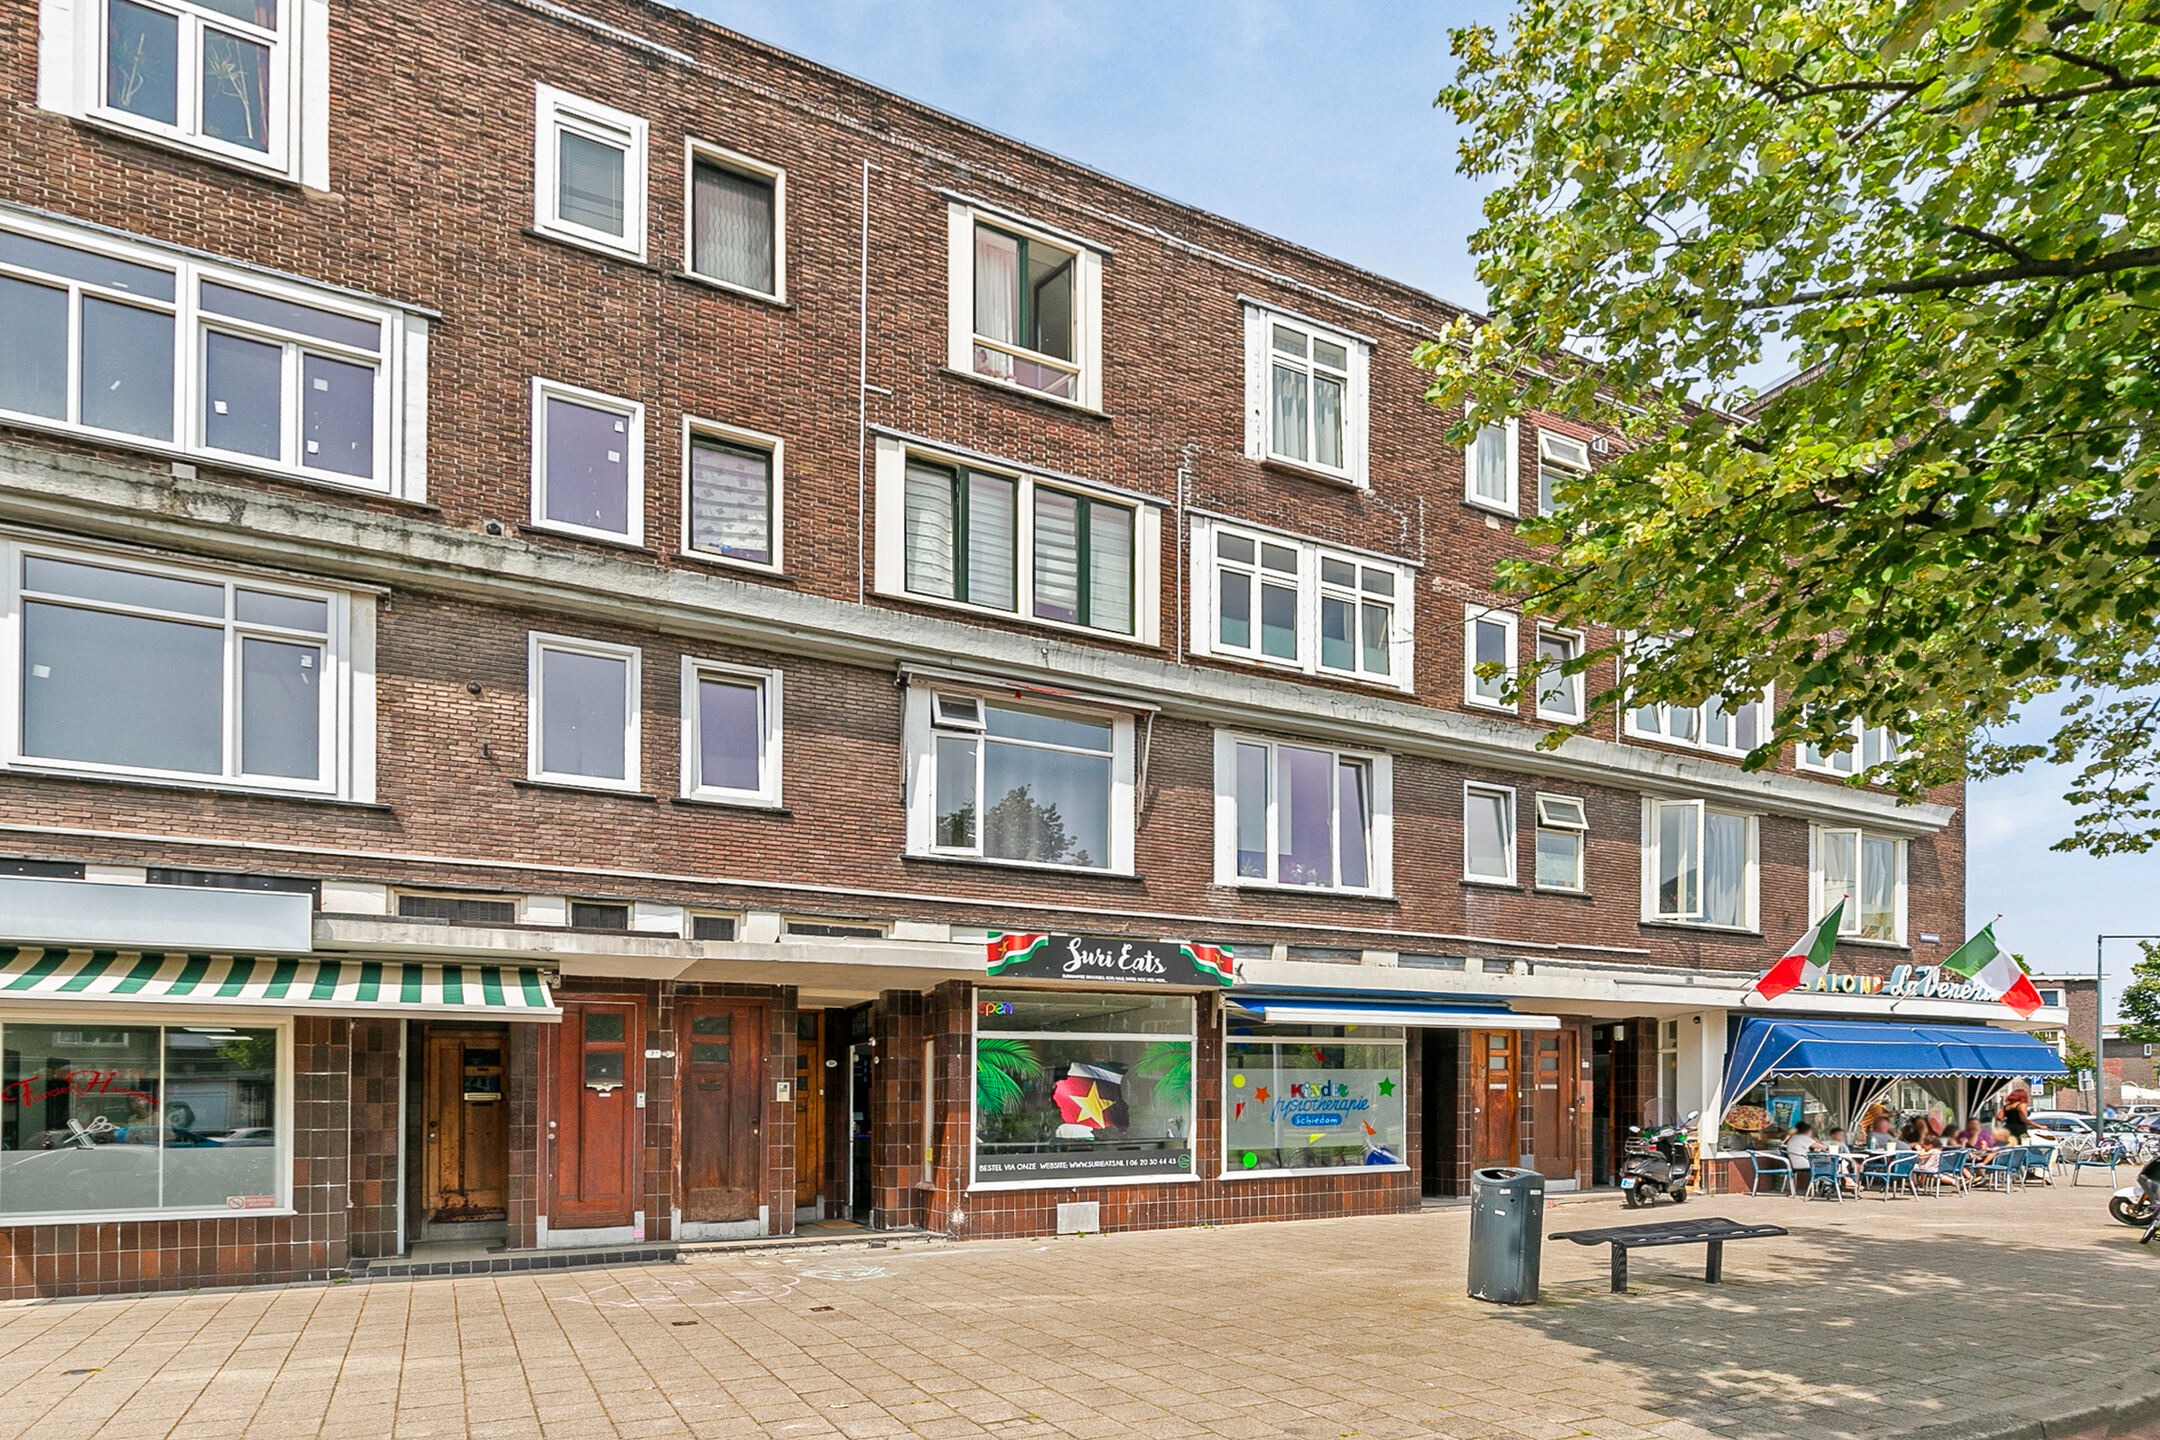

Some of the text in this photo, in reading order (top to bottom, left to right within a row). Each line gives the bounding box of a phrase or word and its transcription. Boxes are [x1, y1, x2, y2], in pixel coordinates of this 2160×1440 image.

[1062, 937, 1167, 974] Suri Eats
[976, 1001, 1013, 1016] open
[1270, 1096, 1370, 1124] fysiotherapie
[979, 1164, 1002, 1172] BESTEL
[1017, 1162, 1037, 1170] ONZE
[1149, 1158, 1157, 1166] 30
